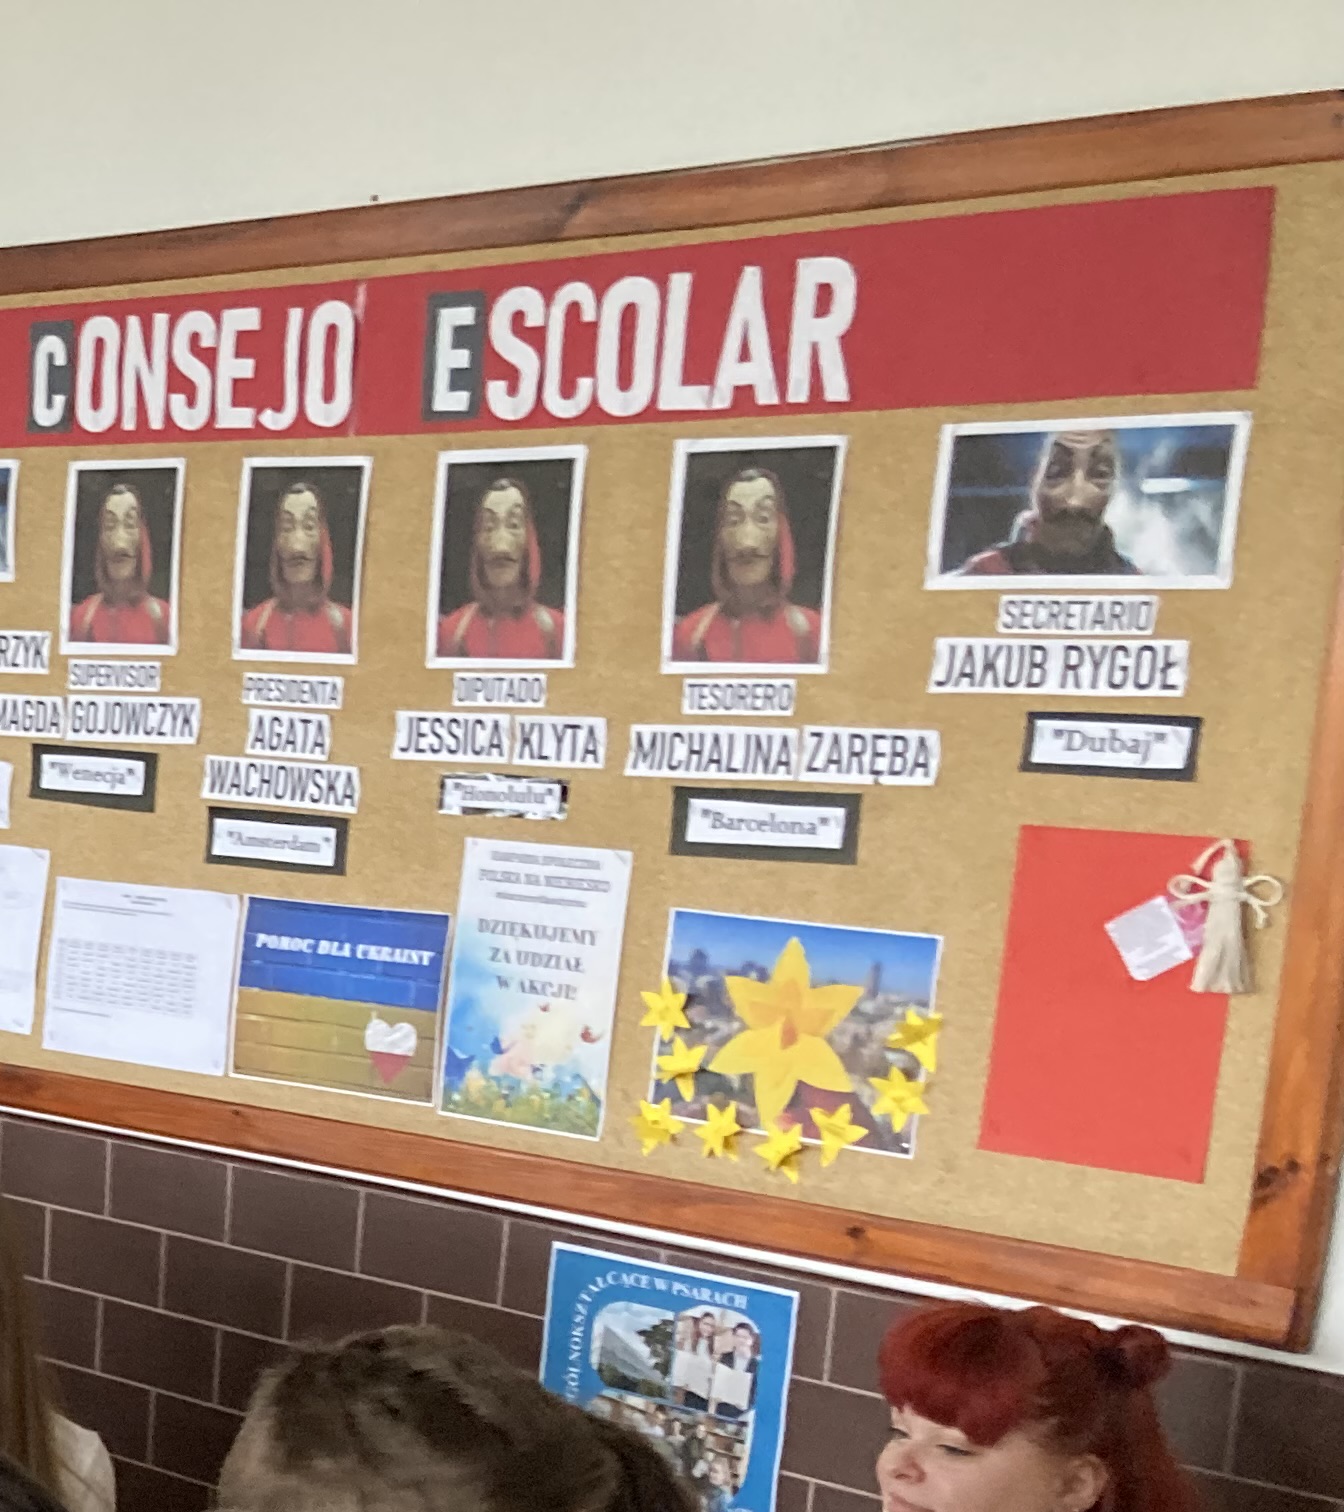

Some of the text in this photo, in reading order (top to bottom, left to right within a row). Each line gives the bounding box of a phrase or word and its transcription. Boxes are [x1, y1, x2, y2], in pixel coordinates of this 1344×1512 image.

[33, 256, 856, 432] CONSEJO ESCOLAR
[1002, 600, 1153, 631] SECRETARIO
[70, 663, 158, 687] SUPERVISOR
[935, 645, 1179, 690] JAKUB RYGOŁ
[244, 677, 339, 704] PRESIDENTA
[457, 677, 544, 703] DIPUTADO
[687, 683, 794, 711] TESORERO
[71, 700, 196, 738] GOJOWCZYK
[250, 715, 326, 755] AGATA
[399, 717, 600, 763] JESSICA KLYTA
[1054, 728, 1167, 764] "Dubaj"
[632, 731, 931, 784] MICHALINA ZARĘBA
[209, 759, 356, 808] WACHOWSKA
[700, 808, 830, 836] "Barcelona"
[478, 917, 599, 947] DZIĘKUJEMY
[316, 939, 352, 957] DLA
[356, 943, 437, 966] UKRAINY
[488, 946, 585, 973] ZA UDZIAŁ
[496, 975, 511, 990] W
[671, 1281, 749, 1310] PISARACH
